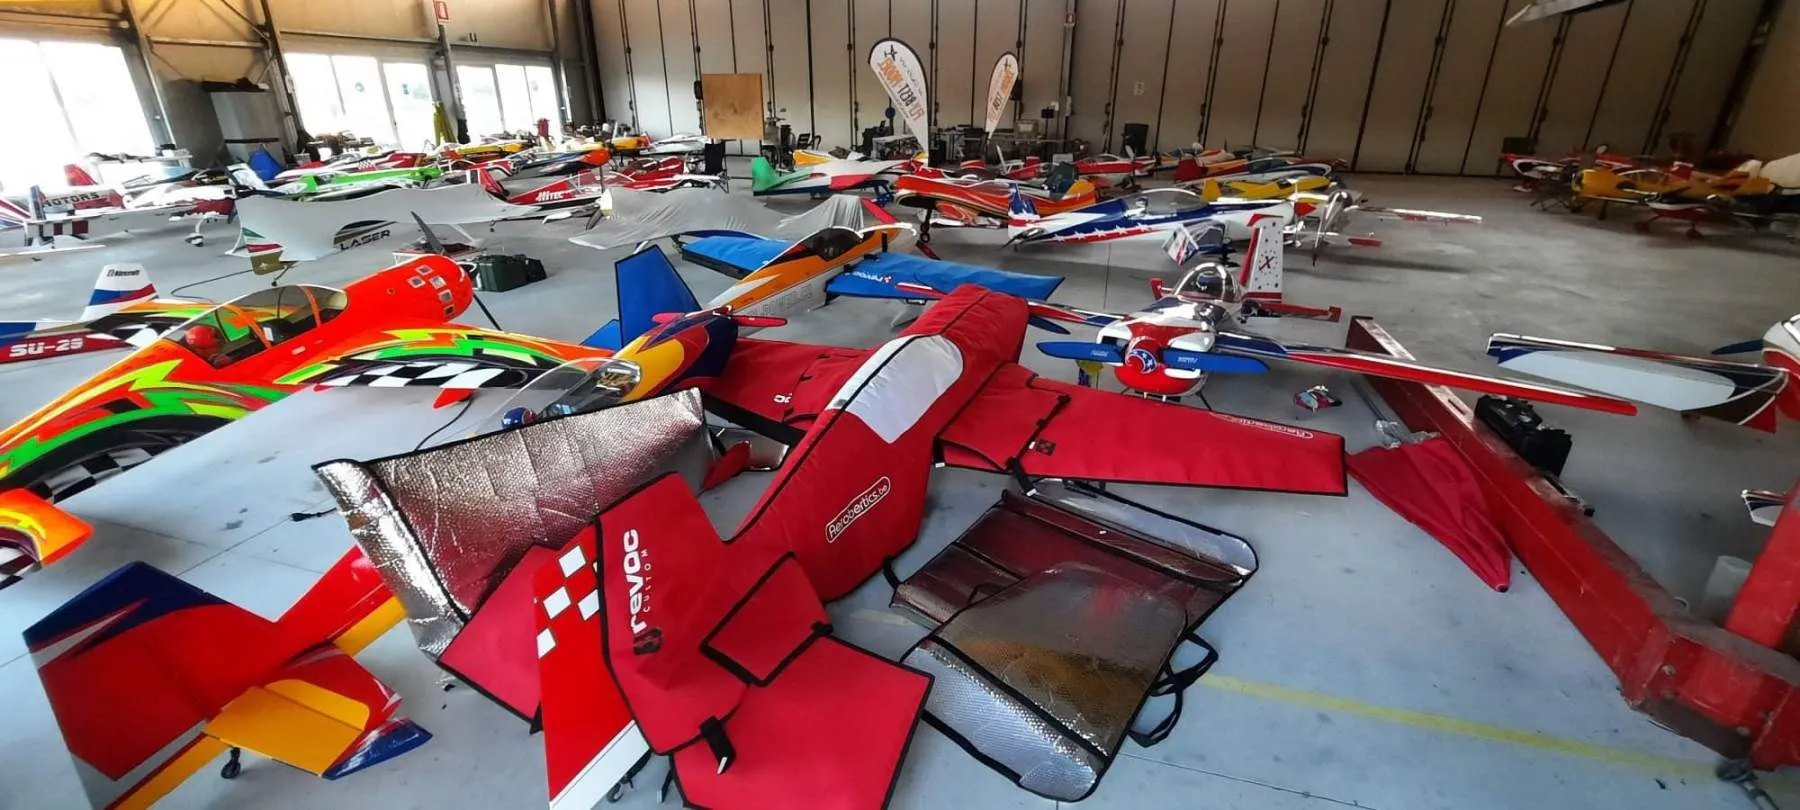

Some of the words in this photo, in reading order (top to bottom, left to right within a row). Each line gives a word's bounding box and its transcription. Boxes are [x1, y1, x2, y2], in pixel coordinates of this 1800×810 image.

[340, 229, 391, 251] LASER
[828, 484, 888, 539] Aerobertics.be
[623, 529, 648, 634] revoc
[641, 549, 652, 613] CUSTOM
